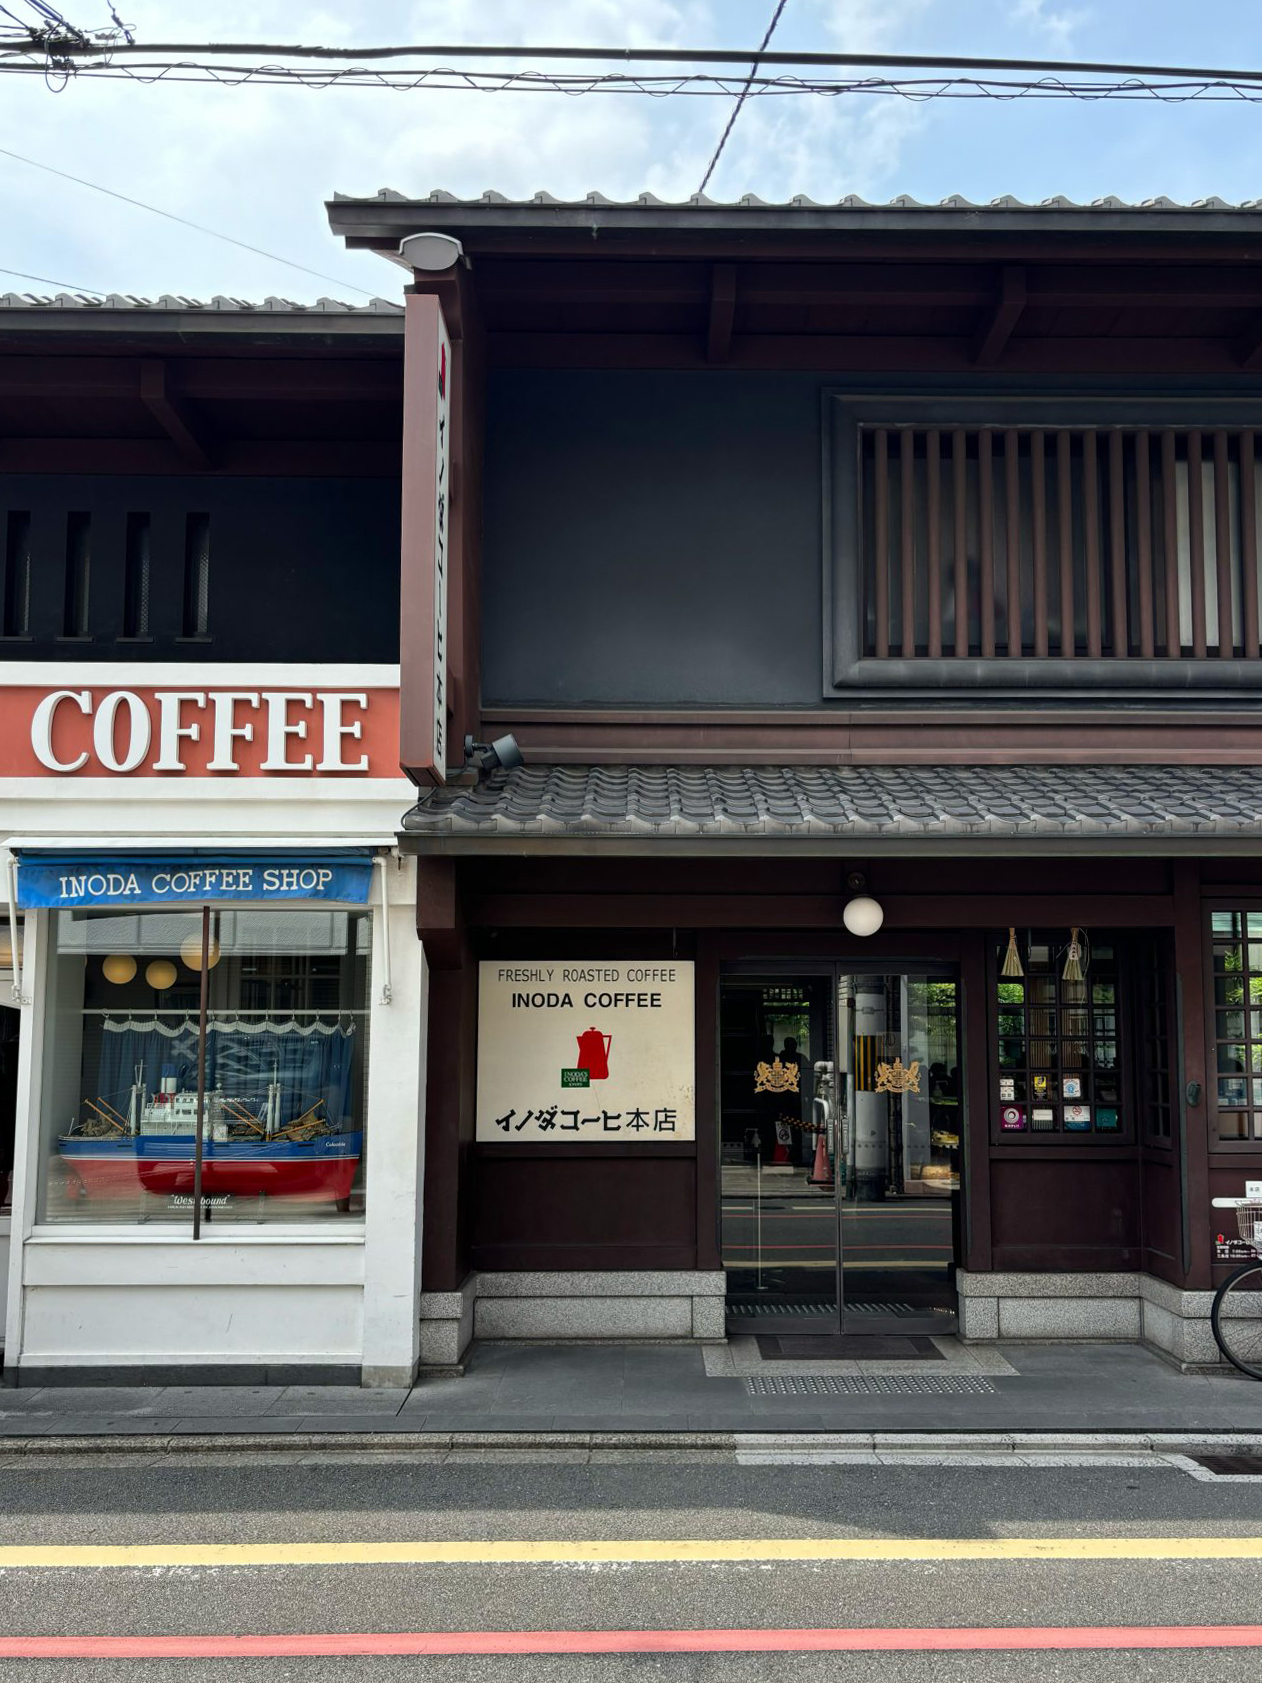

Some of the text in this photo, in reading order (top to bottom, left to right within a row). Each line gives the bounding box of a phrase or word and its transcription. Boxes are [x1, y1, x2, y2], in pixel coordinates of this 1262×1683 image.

[31, 690, 369, 772] COFFEE
[59, 868, 333, 898] INODA COFFEE SHOP
[498, 968, 676, 982] FRESHLY ROASTED COFFEE
[512, 992, 662, 1008] INODA COFFEE
[495, 1105, 677, 1132] イノダコーヒ本店
